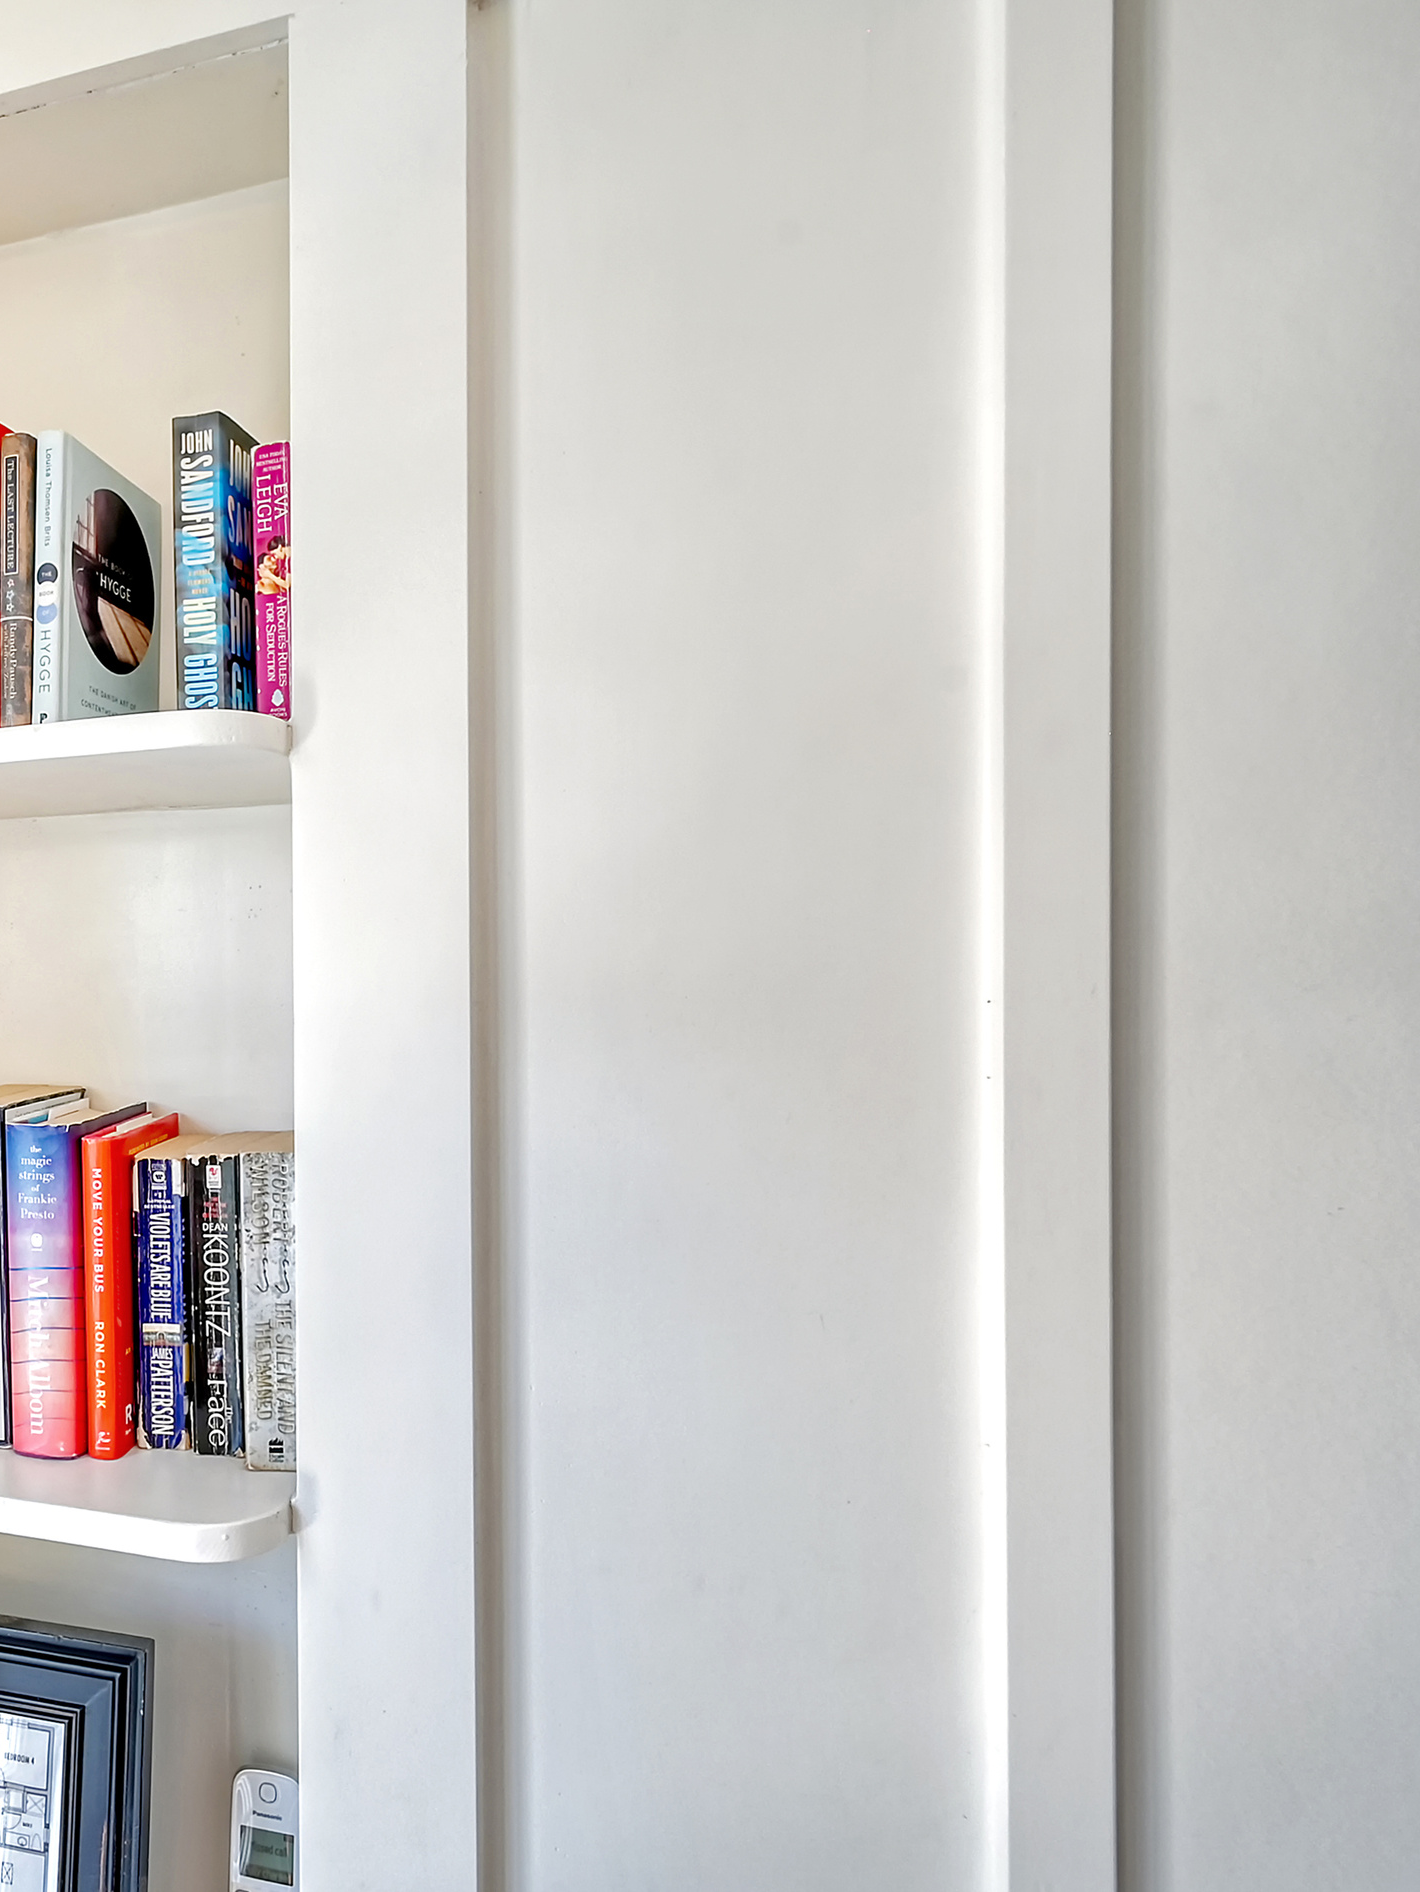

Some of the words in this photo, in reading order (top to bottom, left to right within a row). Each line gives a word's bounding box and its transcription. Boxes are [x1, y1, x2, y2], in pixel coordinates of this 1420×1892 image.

[181, 429, 213, 455] JOHN
[180, 454, 215, 566] SANDFORD
[256, 474, 273, 533] LEIGH
[273, 483, 289, 520] EVA
[7, 516, 15, 570] LECTURE
[100, 573, 131, 602] HYGGE
[277, 595, 287, 604] A
[183, 596, 217, 645] HOLY
[265, 602, 274, 623] FOR
[277, 605, 288, 649] ROGUE'S
[39, 630, 51, 694] HYGGE
[266, 624, 277, 682] SEDUCTION
[278, 652, 288, 686] RULES
[184, 653, 218, 710] GHOS
[21, 1155, 52, 1168] magic
[30, 1145, 42, 1153] the
[18, 1170, 55, 1183] strings
[31, 1184, 40, 1192] of
[92, 1168, 102, 1210] MOVE
[18, 1193, 57, 1205] Frankie
[20, 1208, 55, 1220] Presto
[251, 1163, 270, 1245] WILSON
[272, 1164, 289, 1242] ROBERT
[92, 1217, 103, 1257] YOUR
[149, 1212, 171, 1261] VIOLETS
[202, 1223, 228, 1232] DEAN
[93, 1264, 104, 1293] BUS
[149, 1262, 172, 1290] ARE
[202, 1234, 231, 1337] KOONTZ
[28, 1276, 50, 1348] Mitch
[150, 1290, 172, 1320] BLUE
[275, 1299, 293, 1330] THE
[94, 1321, 105, 1353] RON
[255, 1320, 272, 1349] THE
[275, 1334, 295, 1393] SILENT
[30, 1357, 51, 1435] Albom
[95, 1360, 106, 1409] CLARK
[150, 1359, 175, 1436] PATTERSON
[256, 1353, 274, 1421] DAMNED
[207, 1379, 228, 1447] Face
[277, 1394, 296, 1435] AND
[252, 1810, 283, 1821] Panasonic
